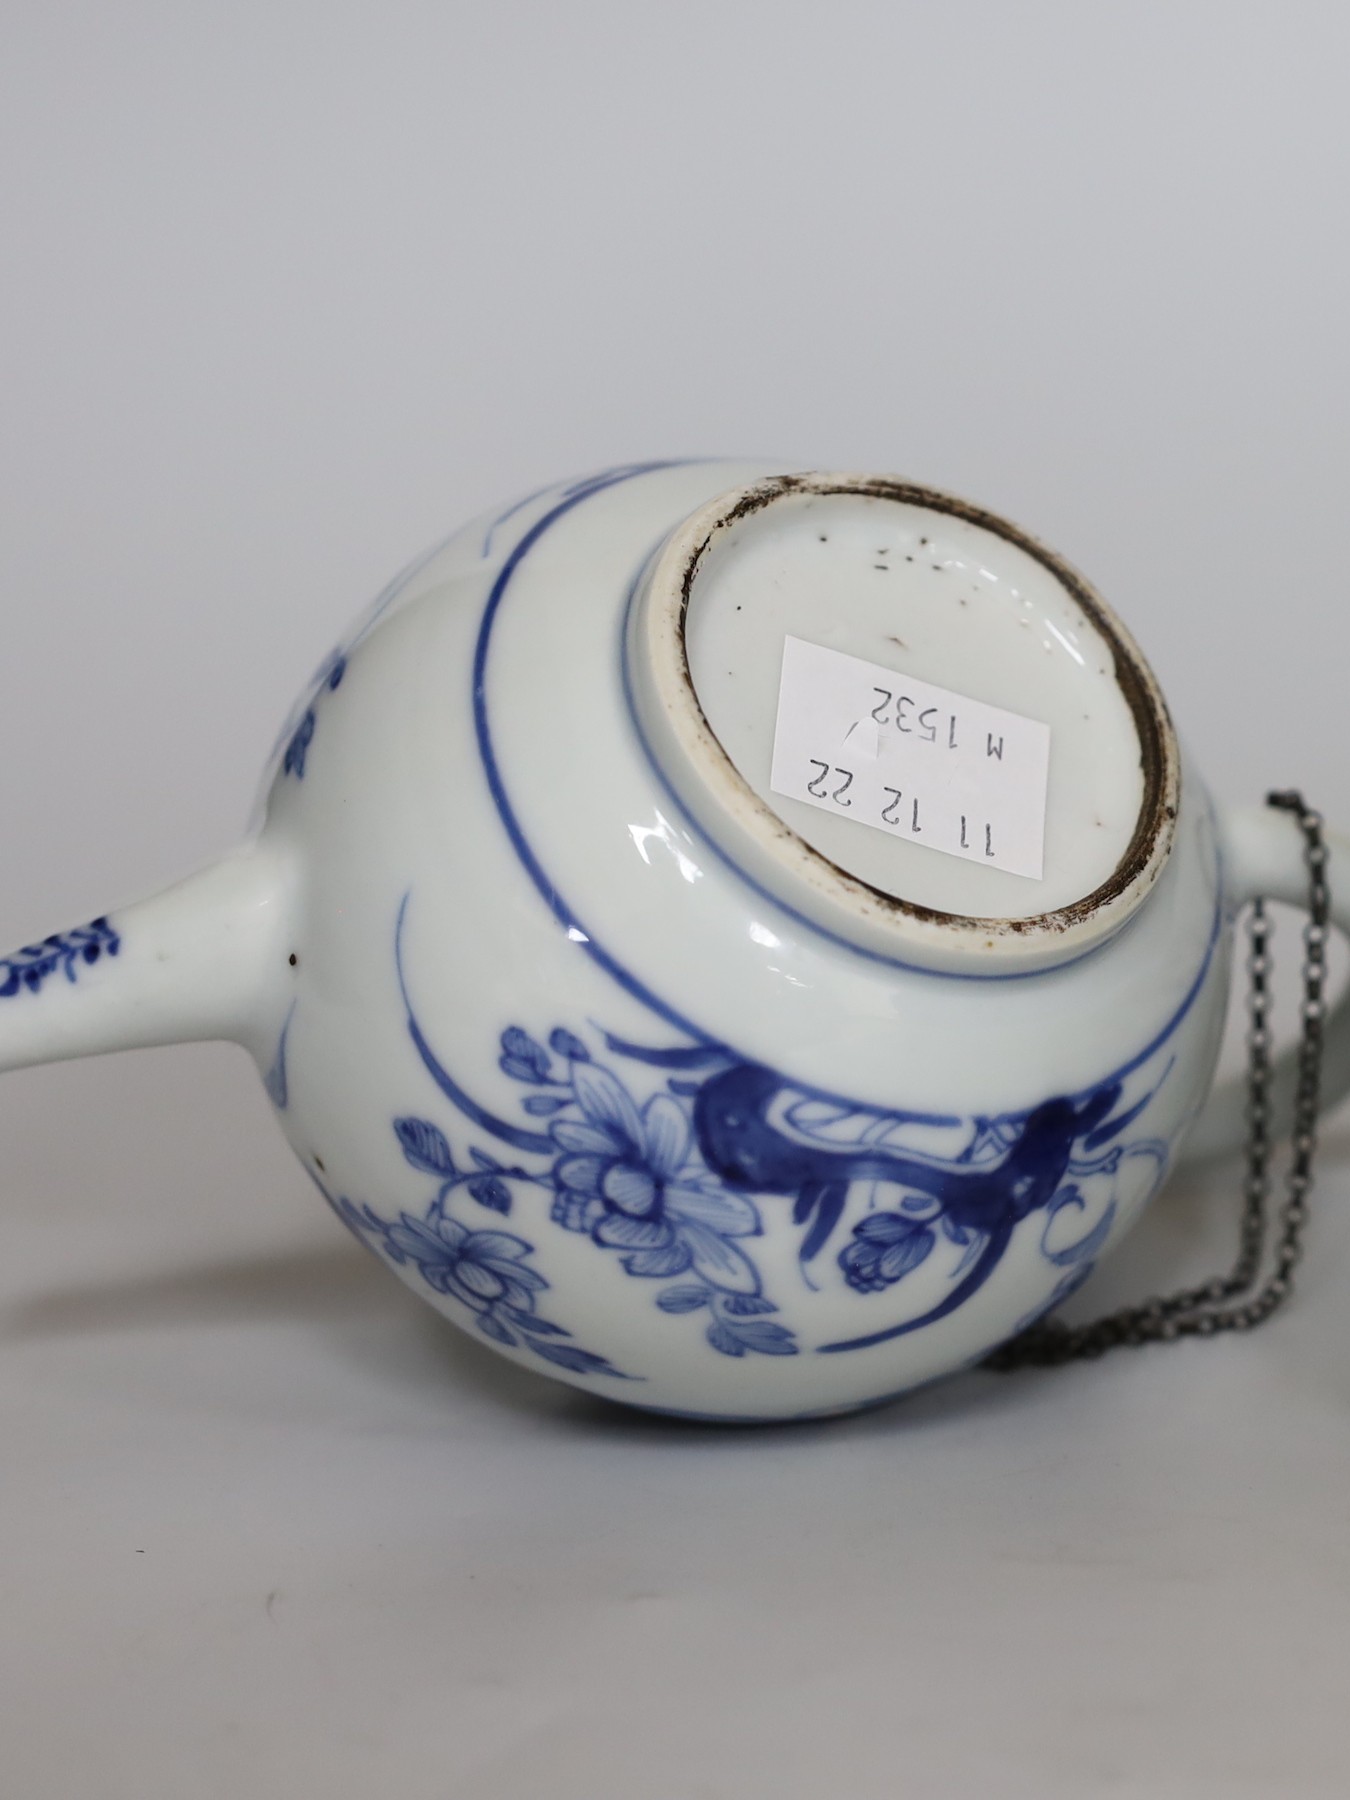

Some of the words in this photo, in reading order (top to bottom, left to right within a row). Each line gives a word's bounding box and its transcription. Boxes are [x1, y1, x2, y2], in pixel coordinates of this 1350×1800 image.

[871, 687, 958, 749] 1532
[987, 733, 1004, 761] M
[807, 760, 854, 807] 22
[881, 787, 922, 833] 12
[960, 816, 995, 857] 11
